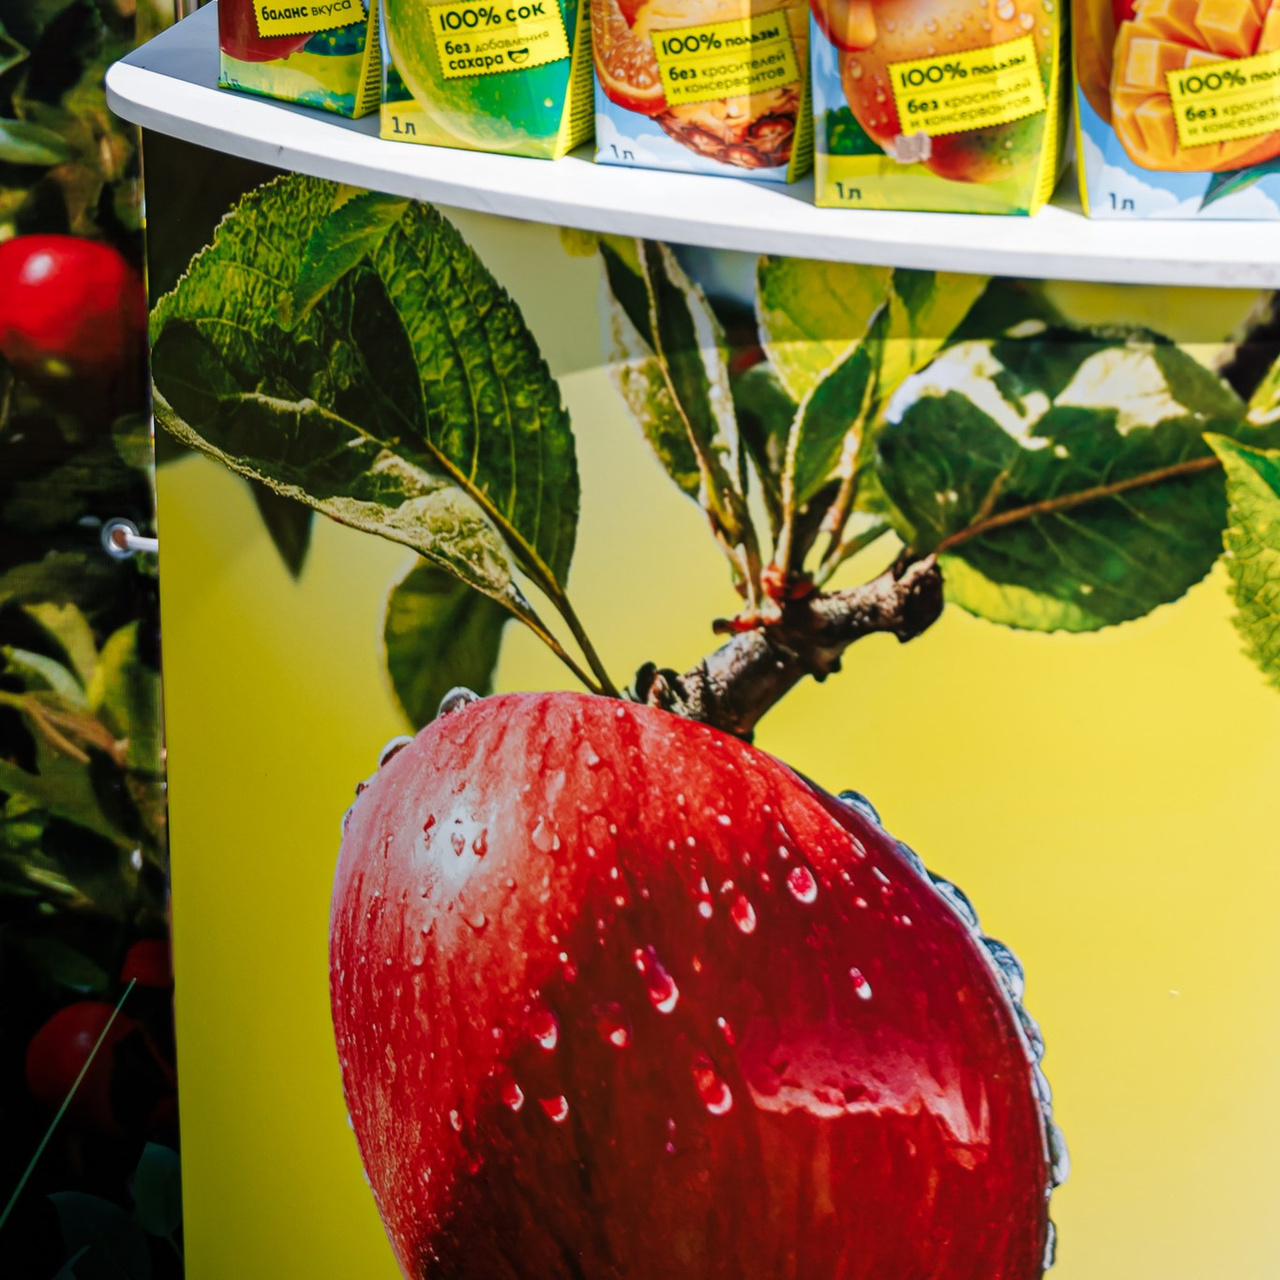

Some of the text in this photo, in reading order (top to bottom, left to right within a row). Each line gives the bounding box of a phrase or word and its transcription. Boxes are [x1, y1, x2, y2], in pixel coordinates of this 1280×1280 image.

[261, 0, 352, 21] баланс вкуса
[440, 3, 546, 31] 100% сок
[445, 31, 550, 55] без добавления
[662, 27, 779, 55] 100% пользы
[449, 55, 504, 70] сахара
[669, 48, 786, 81] без красителей
[901, 62, 967, 87] 100%
[672, 67, 785, 94] и консервантов
[1179, 70, 1246, 95] 100%
[907, 99, 938, 114] без
[1186, 107, 1216, 121] без
